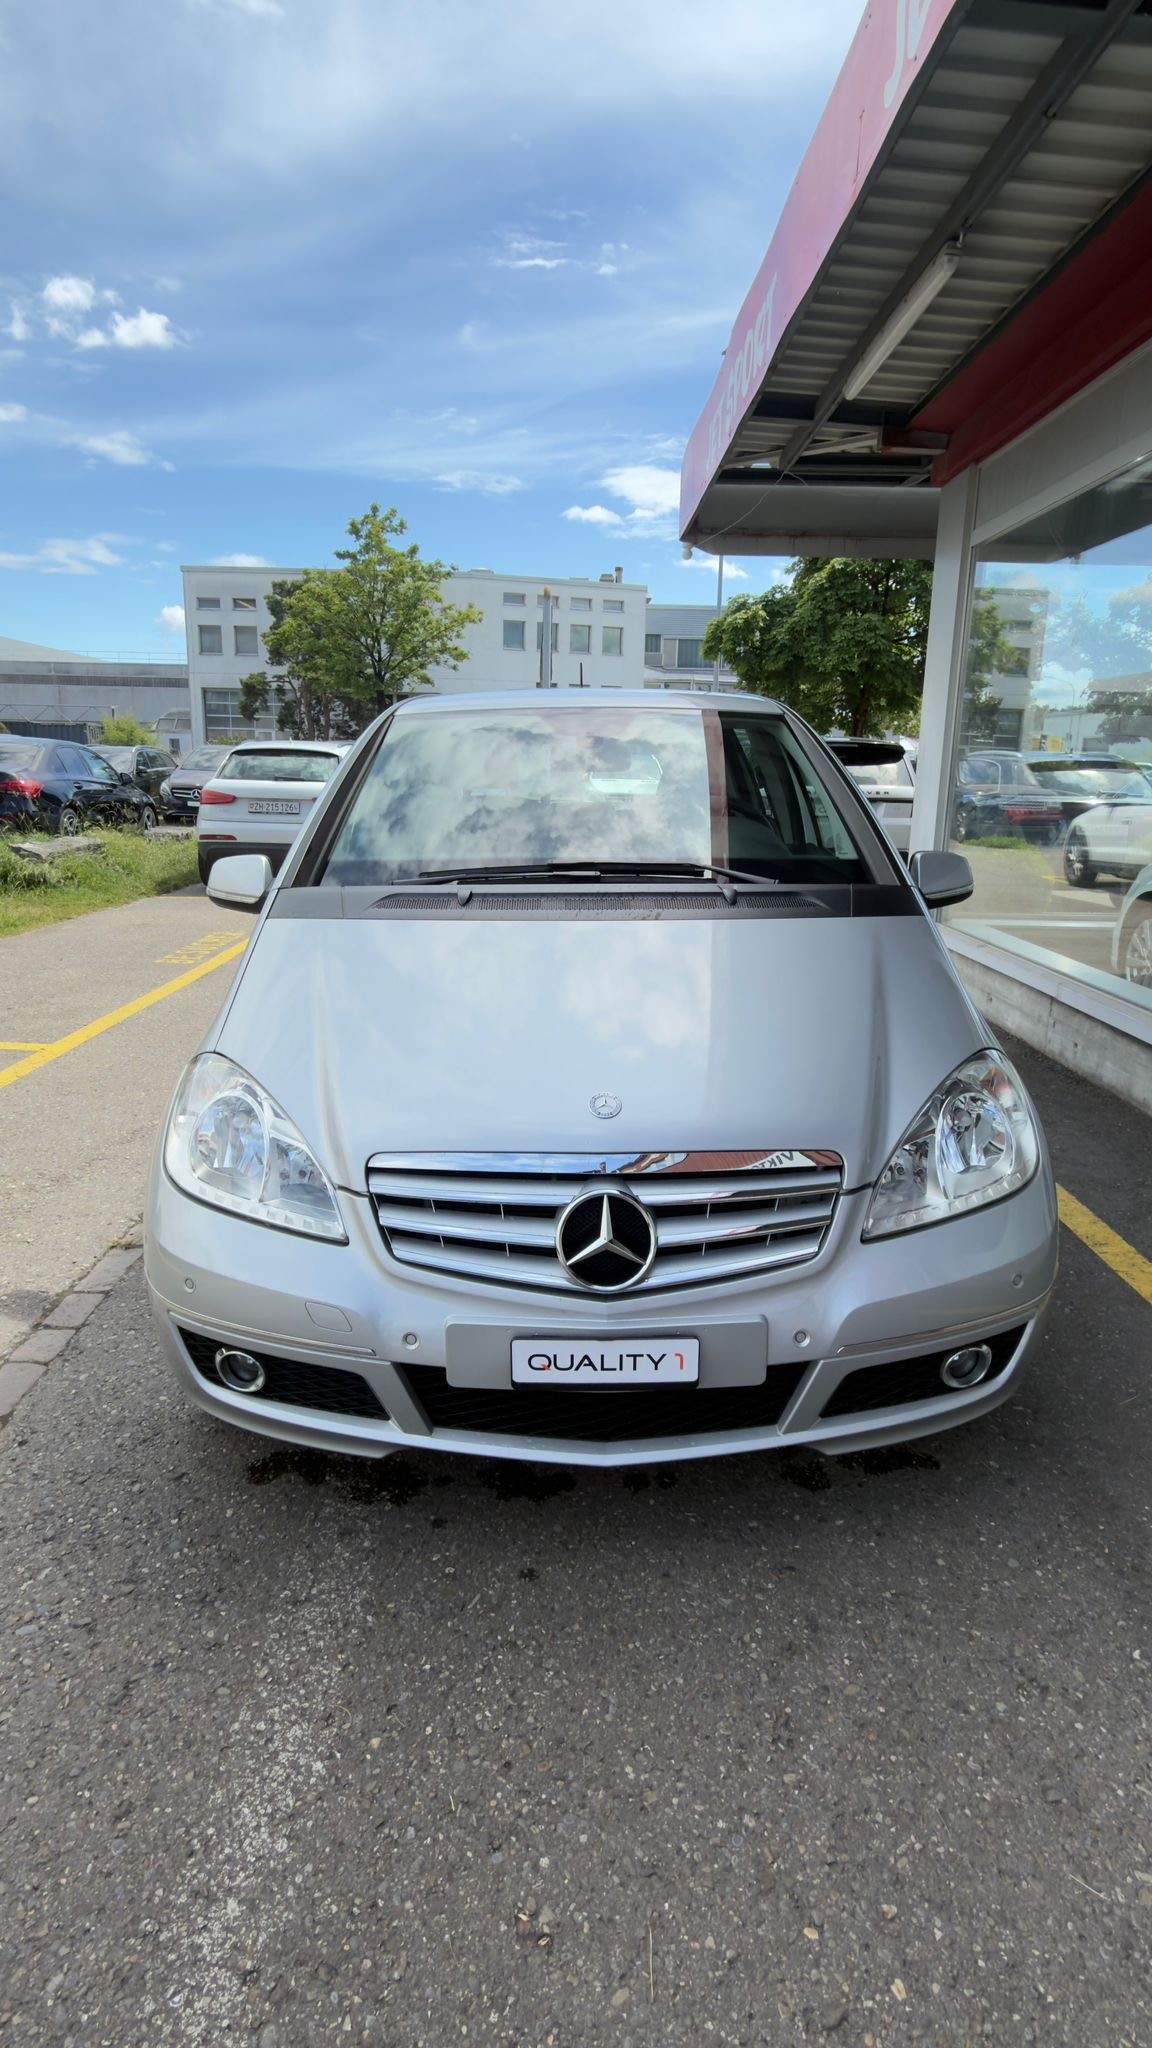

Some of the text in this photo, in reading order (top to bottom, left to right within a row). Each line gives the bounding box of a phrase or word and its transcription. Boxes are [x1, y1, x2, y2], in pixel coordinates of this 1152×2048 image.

[254, 802, 264, 811] ZH
[527, 1352, 685, 1372] QUALITY 1
